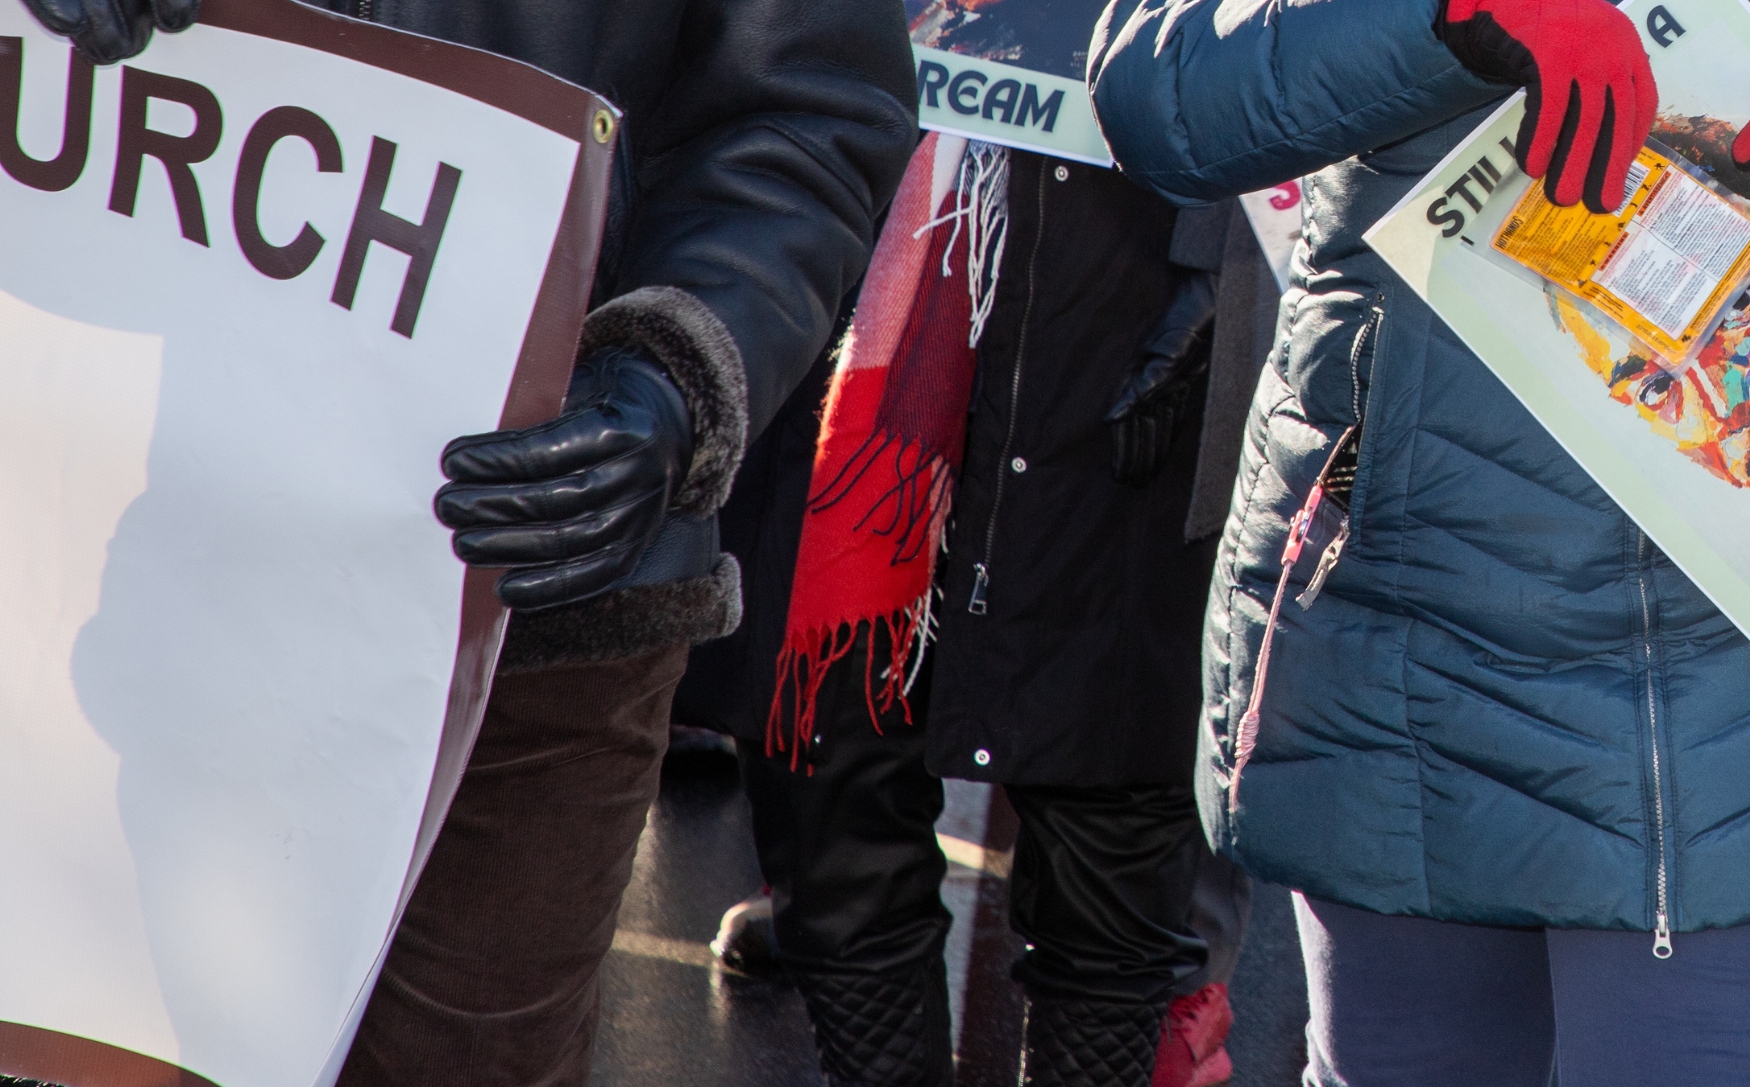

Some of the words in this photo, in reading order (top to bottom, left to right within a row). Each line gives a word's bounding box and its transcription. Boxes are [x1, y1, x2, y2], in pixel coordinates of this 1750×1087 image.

[1646, 4, 1686, 49] A
[917, 59, 1066, 133] REAM
[0, 36, 463, 340] URCH
